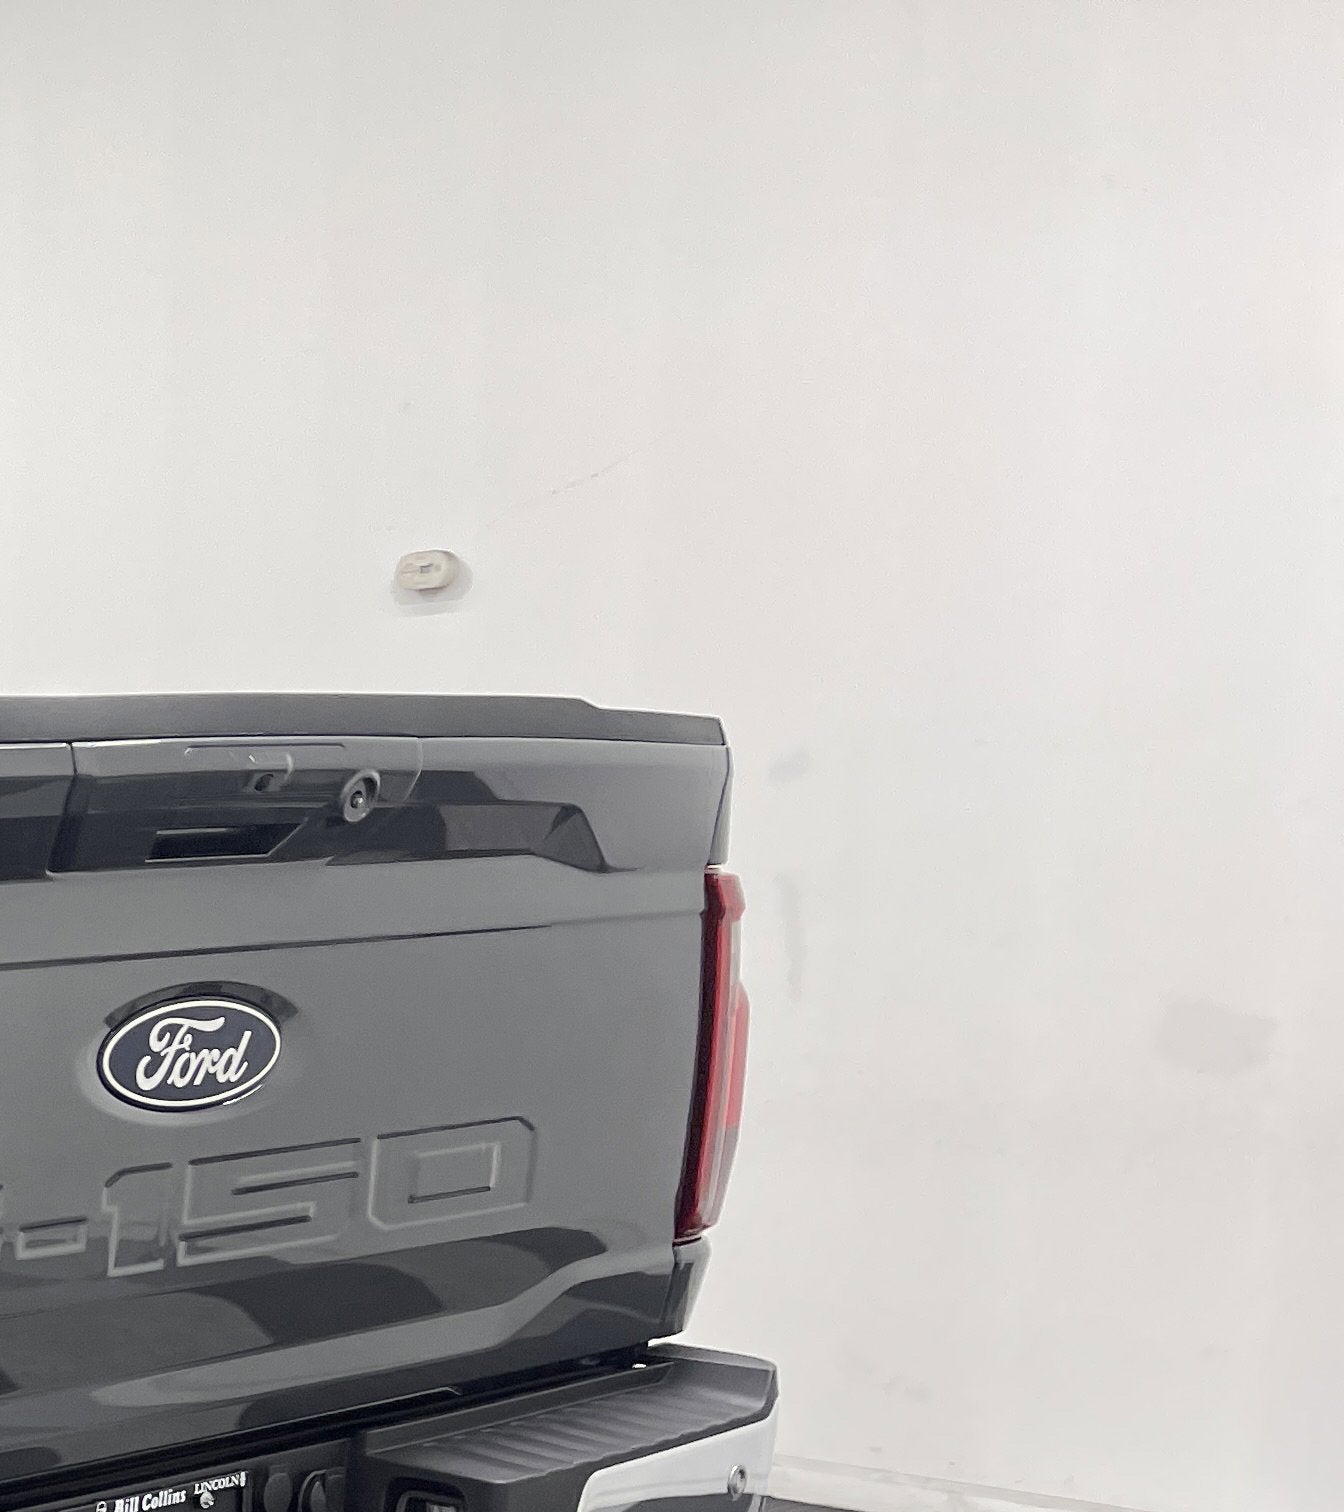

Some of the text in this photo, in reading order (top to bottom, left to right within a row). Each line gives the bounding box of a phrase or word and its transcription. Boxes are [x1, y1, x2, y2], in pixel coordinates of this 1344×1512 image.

[135, 1016, 252, 1091] Ford
[142, 1489, 186, 1512] Collins
[194, 1474, 240, 1494] LINCOLN
